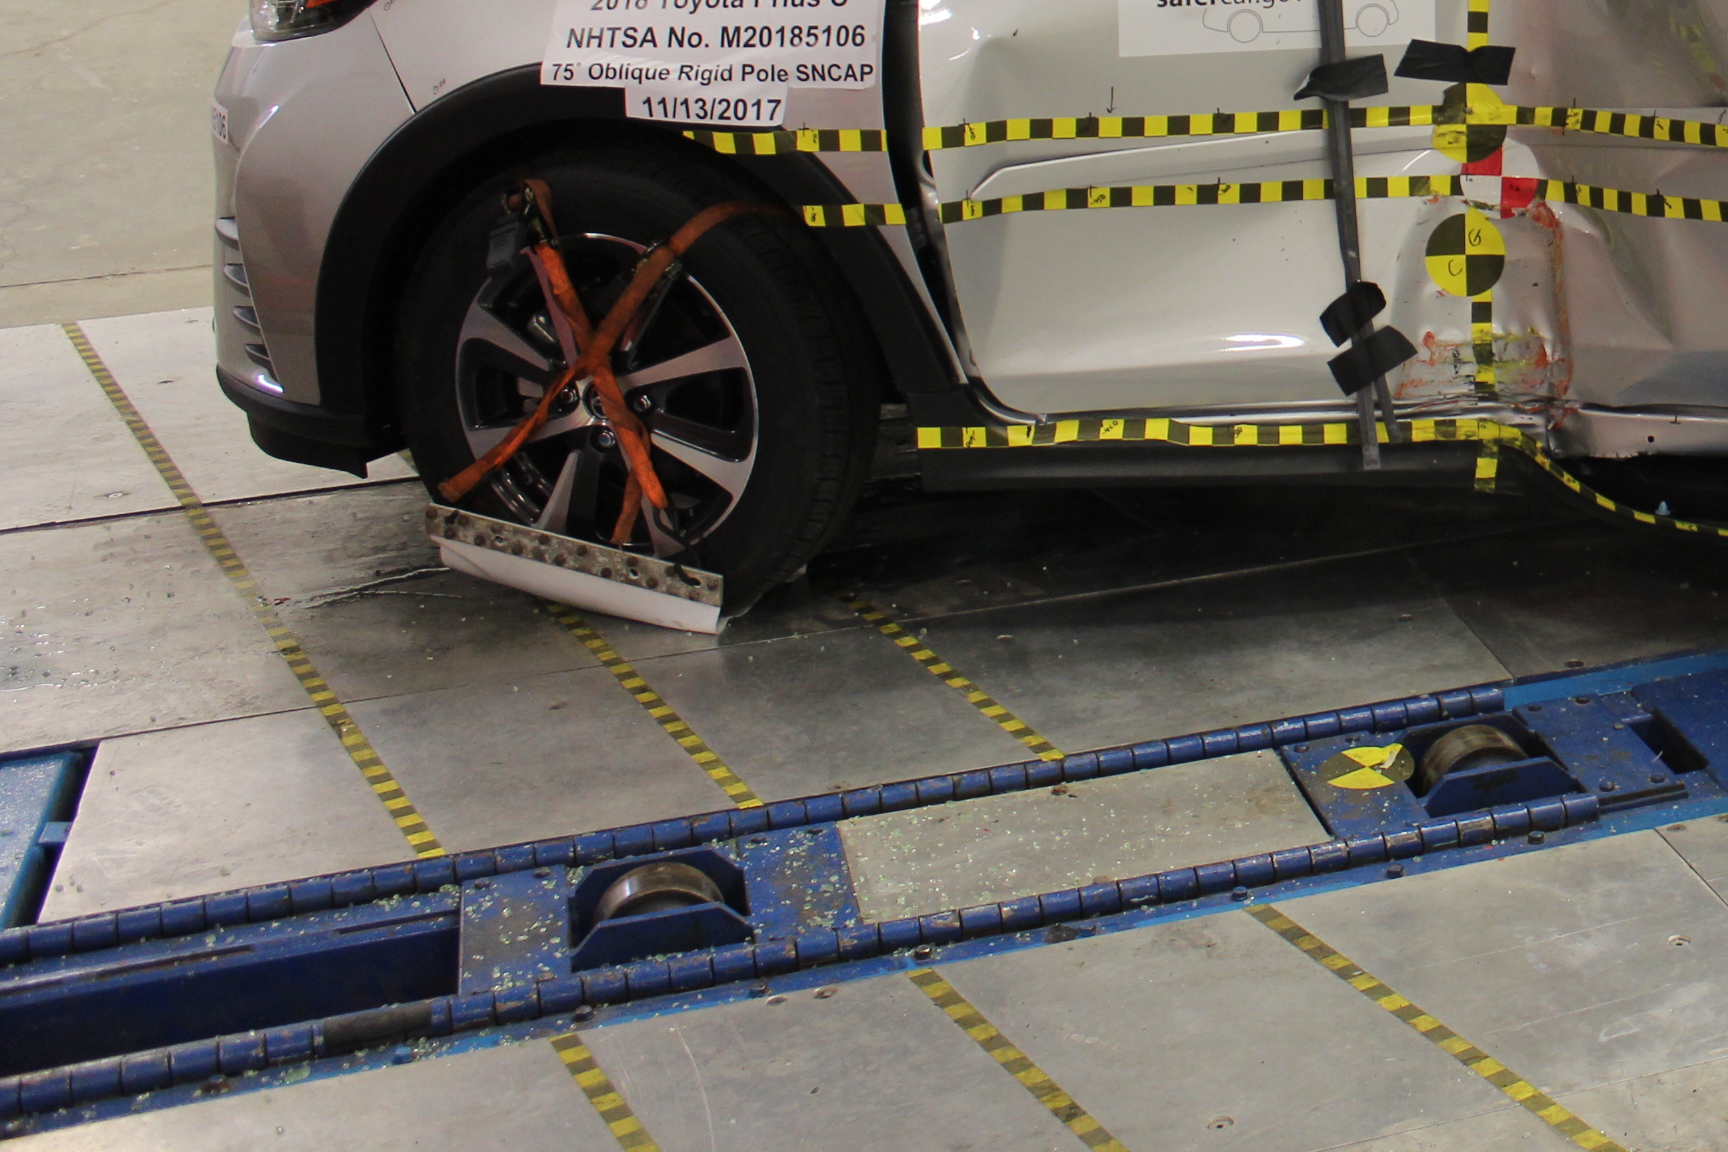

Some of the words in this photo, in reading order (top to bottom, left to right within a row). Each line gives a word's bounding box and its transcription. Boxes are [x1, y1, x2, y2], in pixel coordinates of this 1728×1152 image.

[566, 26, 658, 49] NHTSA
[667, 26, 710, 49] No.
[720, 24, 866, 48] M20185106
[588, 62, 670, 85] Oblique
[677, 63, 734, 86] Rigid
[741, 63, 789, 82] Pole
[796, 63, 874, 82] SNCAP
[642, 96, 782, 122] 11/13/2017
